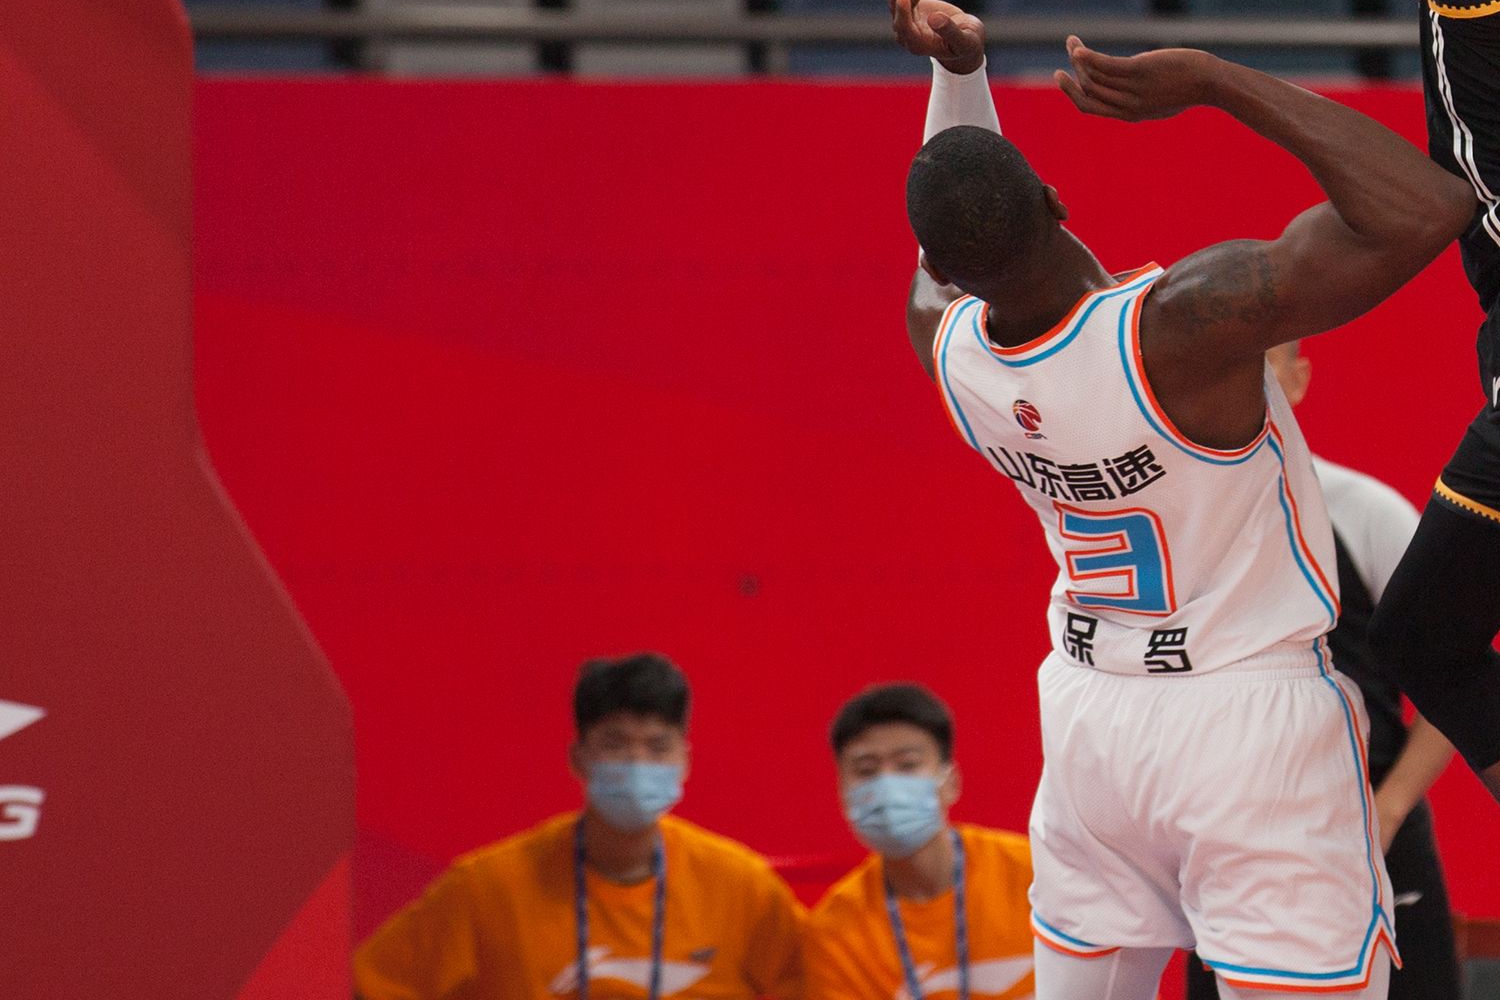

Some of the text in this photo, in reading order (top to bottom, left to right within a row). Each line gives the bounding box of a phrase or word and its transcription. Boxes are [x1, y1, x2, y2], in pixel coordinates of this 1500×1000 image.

[987, 444, 1167, 502] 山东高速
[1052, 500, 1178, 617] 3
